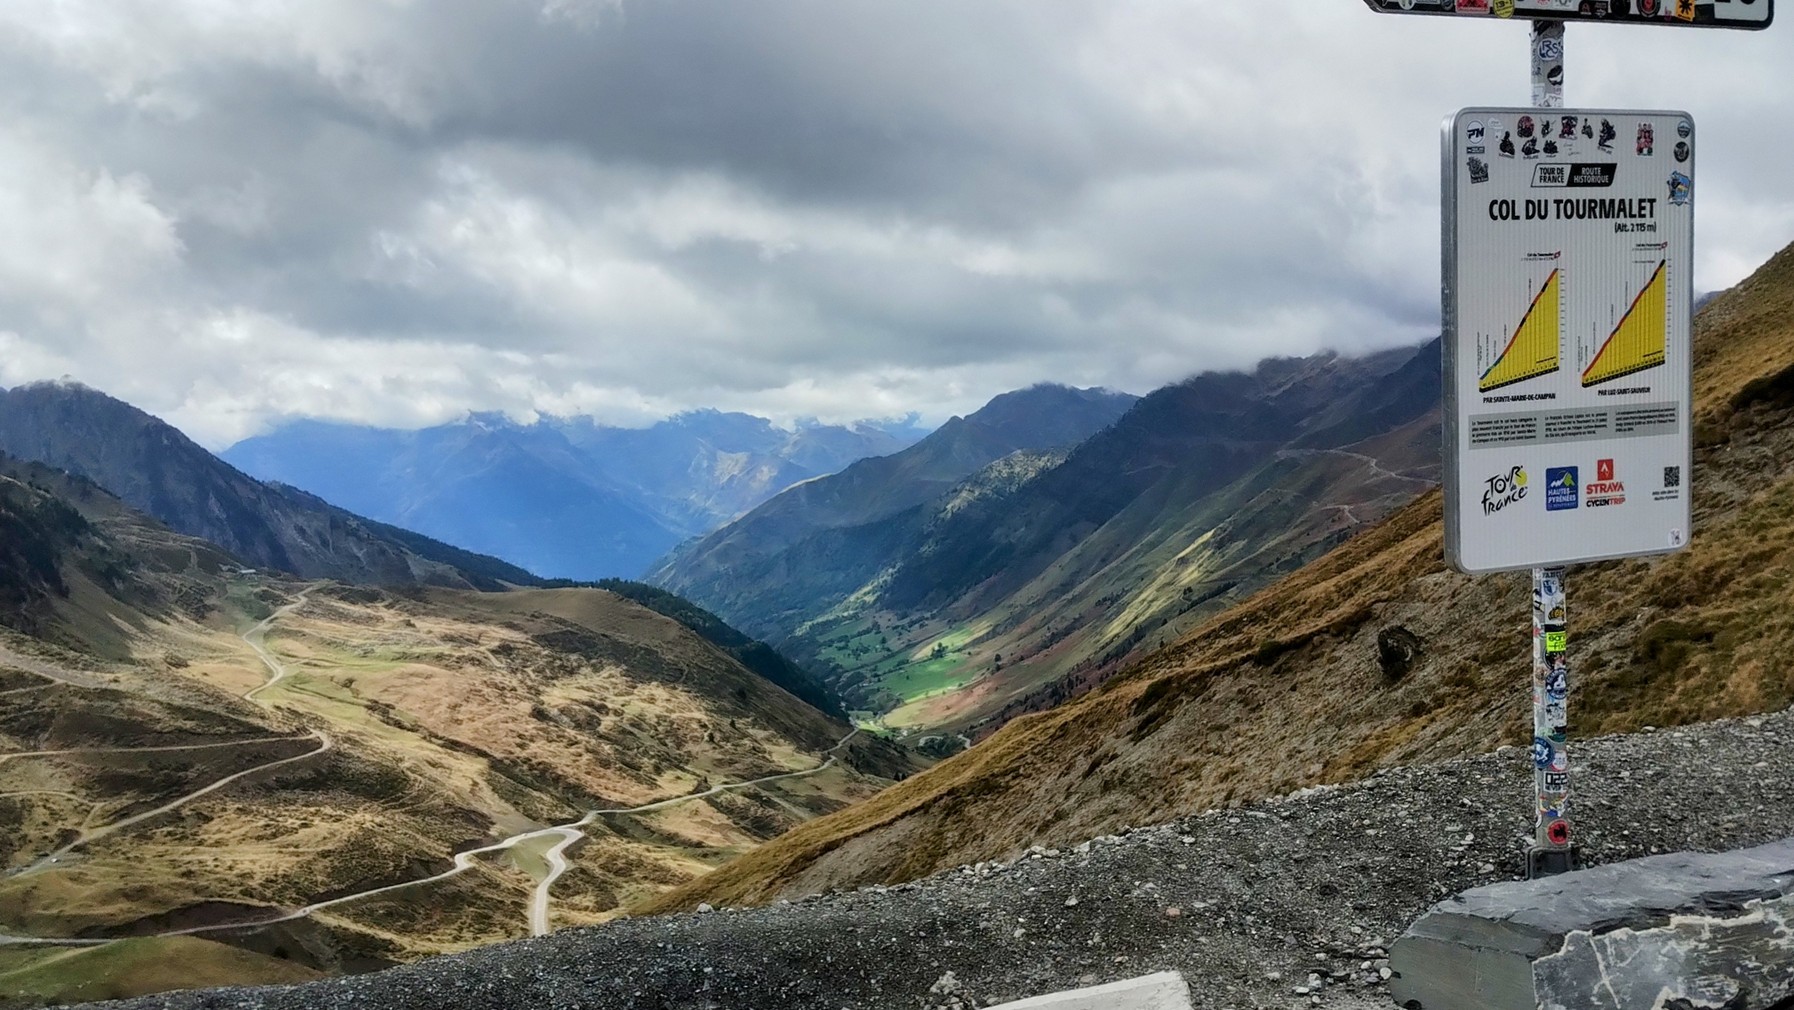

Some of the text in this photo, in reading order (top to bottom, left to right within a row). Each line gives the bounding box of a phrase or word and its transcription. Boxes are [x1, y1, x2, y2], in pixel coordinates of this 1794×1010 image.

[1539, 167, 1564, 175] TOUR DE
[1581, 167, 1601, 175] ROUTE
[1539, 175, 1564, 184] FRANCE
[1573, 175, 1609, 184] HISTORIQUE
[1489, 198, 1657, 221] COL DU TOURMALET
[1614, 221, 1629, 233] (Alt.
[1586, 481, 1624, 495] STRAVA
